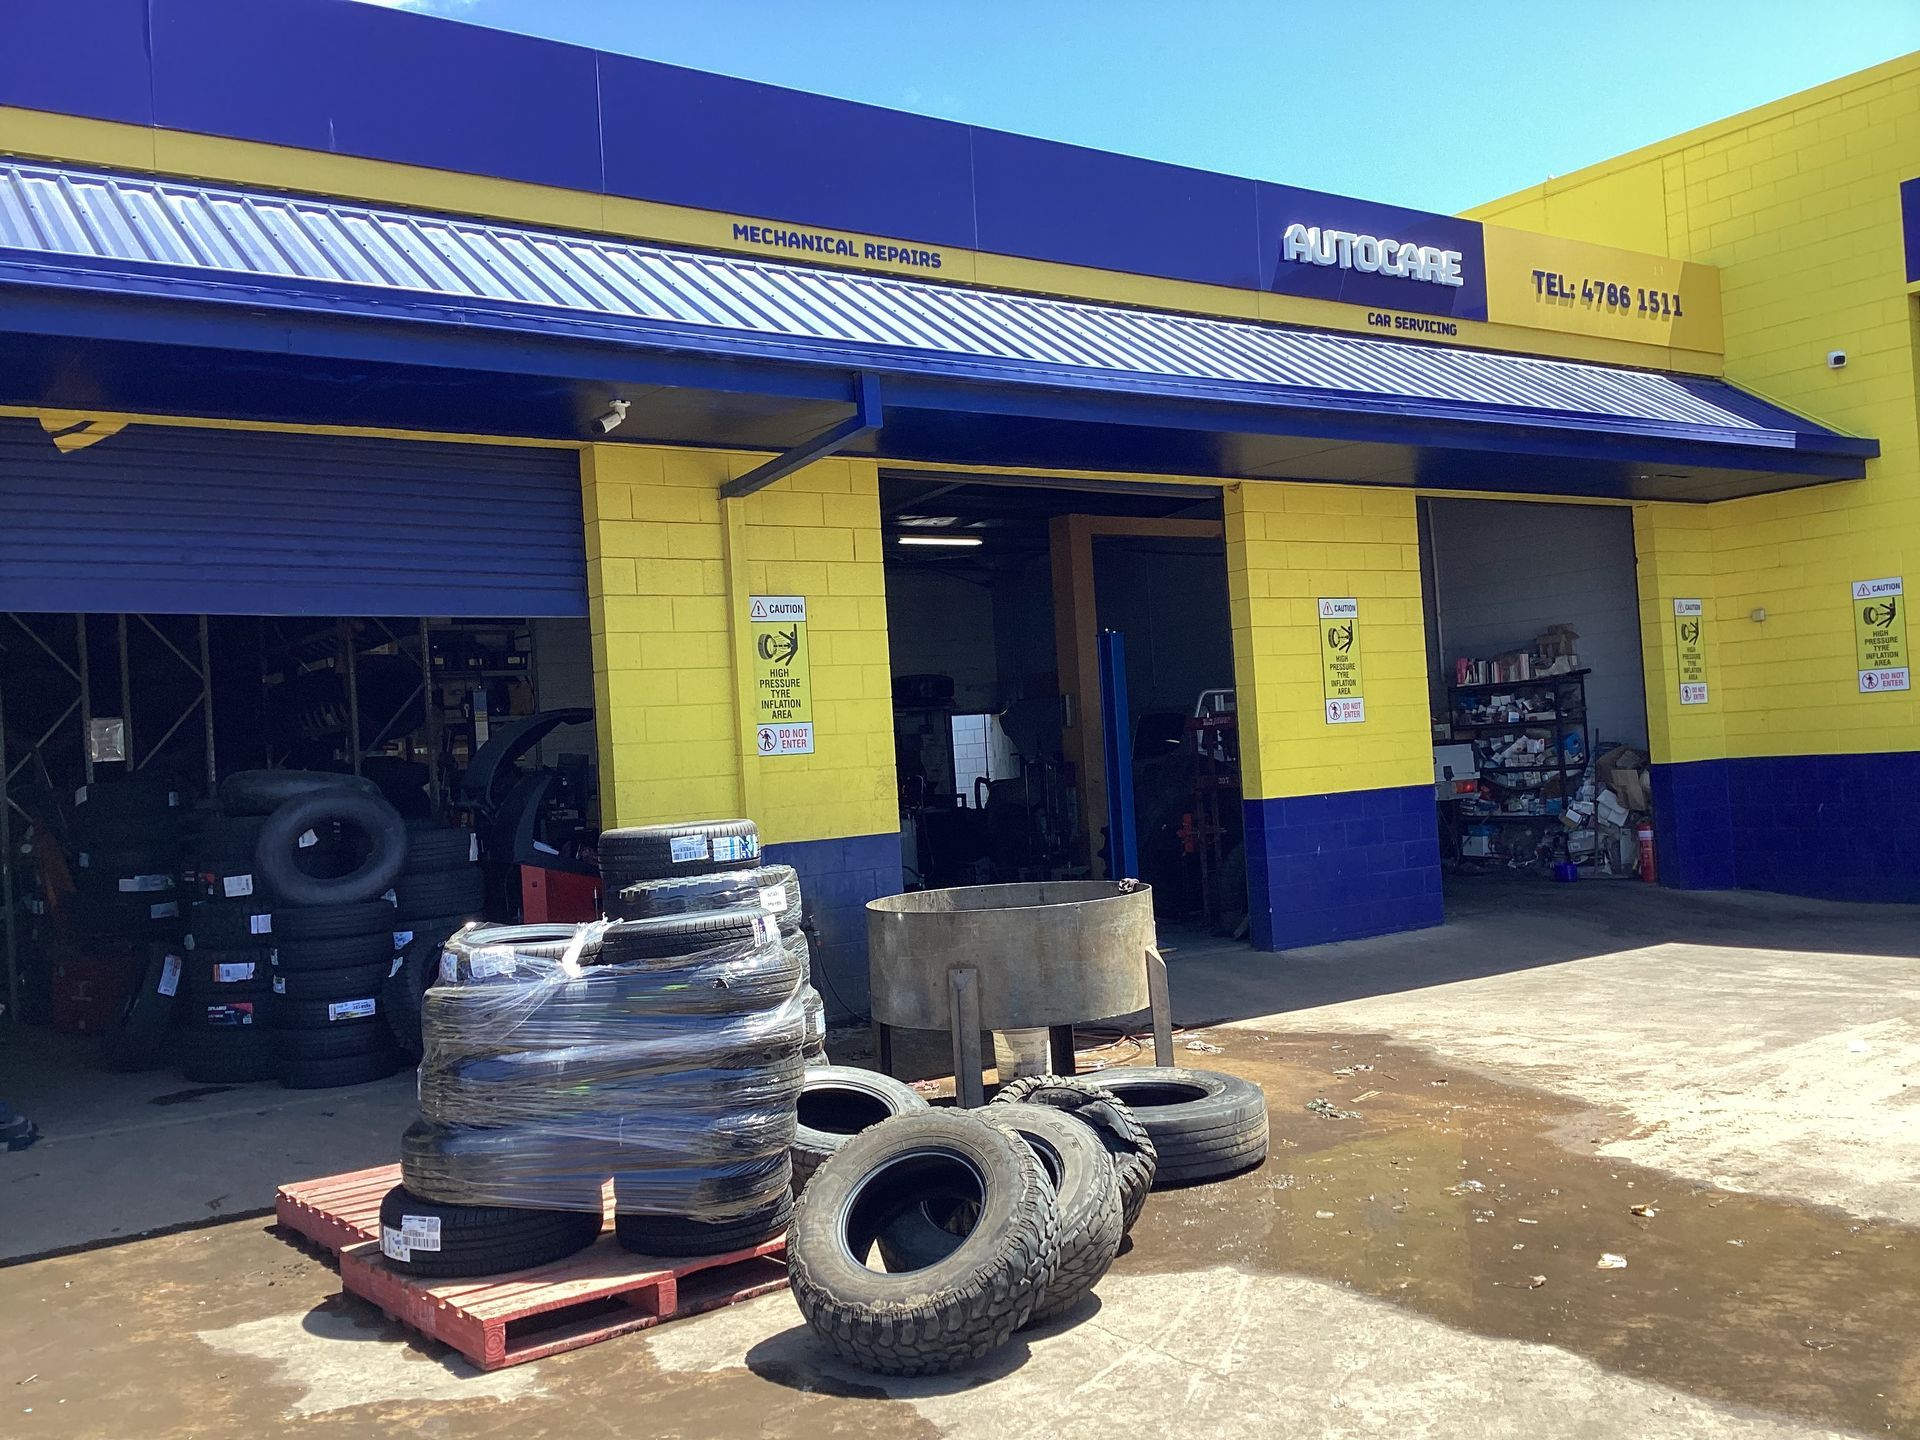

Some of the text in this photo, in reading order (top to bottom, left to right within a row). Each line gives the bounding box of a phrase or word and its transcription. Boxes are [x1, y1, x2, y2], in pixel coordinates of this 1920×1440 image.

[733, 223, 942, 269] MECHANICAL REPAIRS
[1283, 223, 1464, 287] AUTOCARE
[1532, 270, 1683, 316] TEL: 4786 1511
[1367, 312, 1457, 336] CAR SERVICING
[1872, 583, 1900, 592] CAUTION
[769, 604, 803, 614] CAUTION
[1334, 604, 1356, 612] CAUTION
[1864, 636, 1898, 645] PRESSURE
[1873, 644, 1890, 652] TYRE
[1336, 655, 1348, 663] HIGH
[1866, 652, 1898, 660] INFLATION
[1330, 663, 1356, 671] PRESSURE
[770, 668, 789, 678] HIGH
[1337, 671, 1349, 679] TYRE
[760, 679, 800, 688] PRESSURE
[1331, 679, 1356, 687] INFLATION
[771, 689, 791, 698] TYRE
[1338, 687, 1351, 695] AREA
[761, 699, 801, 709] INFLATION
[772, 710, 792, 719] AREA
[1344, 710, 1361, 718] ENTER
[779, 729, 808, 738] DO NOT
[782, 739, 807, 748] ENTER
